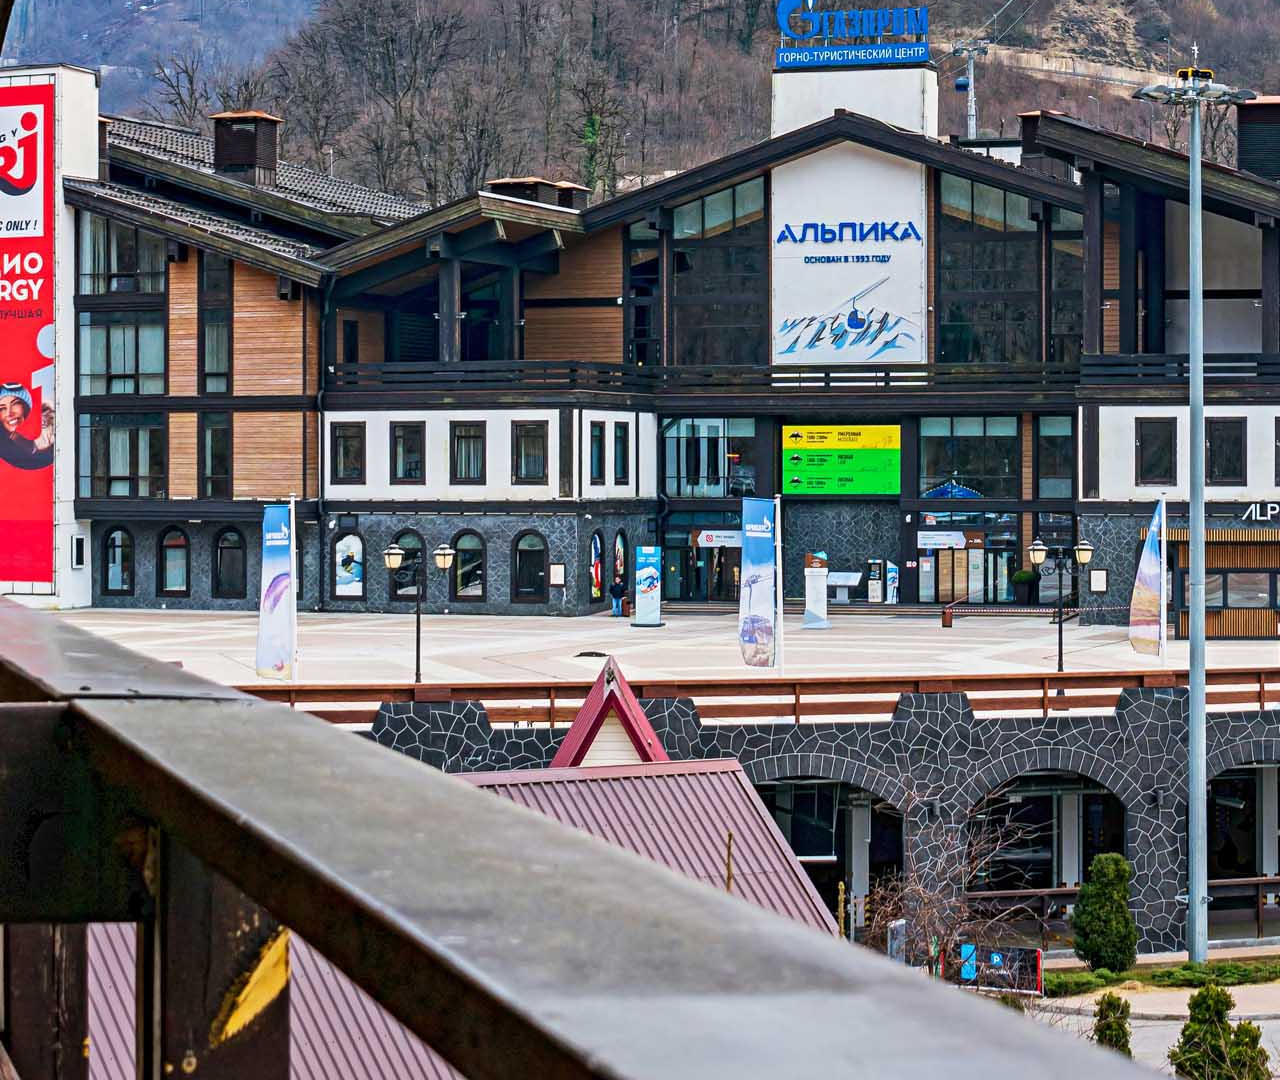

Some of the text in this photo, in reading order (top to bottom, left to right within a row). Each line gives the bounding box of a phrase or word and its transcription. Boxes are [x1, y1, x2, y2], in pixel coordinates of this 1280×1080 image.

[823, 7, 928, 39] ГАЗПРОМ
[779, 47, 926, 63] ГОРНО-ТУРИСТИЧЕСКИЙ ЦЕНТР
[5, 220, 31, 232] ONLY
[777, 221, 922, 244] АЛЬПИКА
[804, 256, 841, 264] ОСНОВАН
[872, 254, 891, 263] ГОДУ
